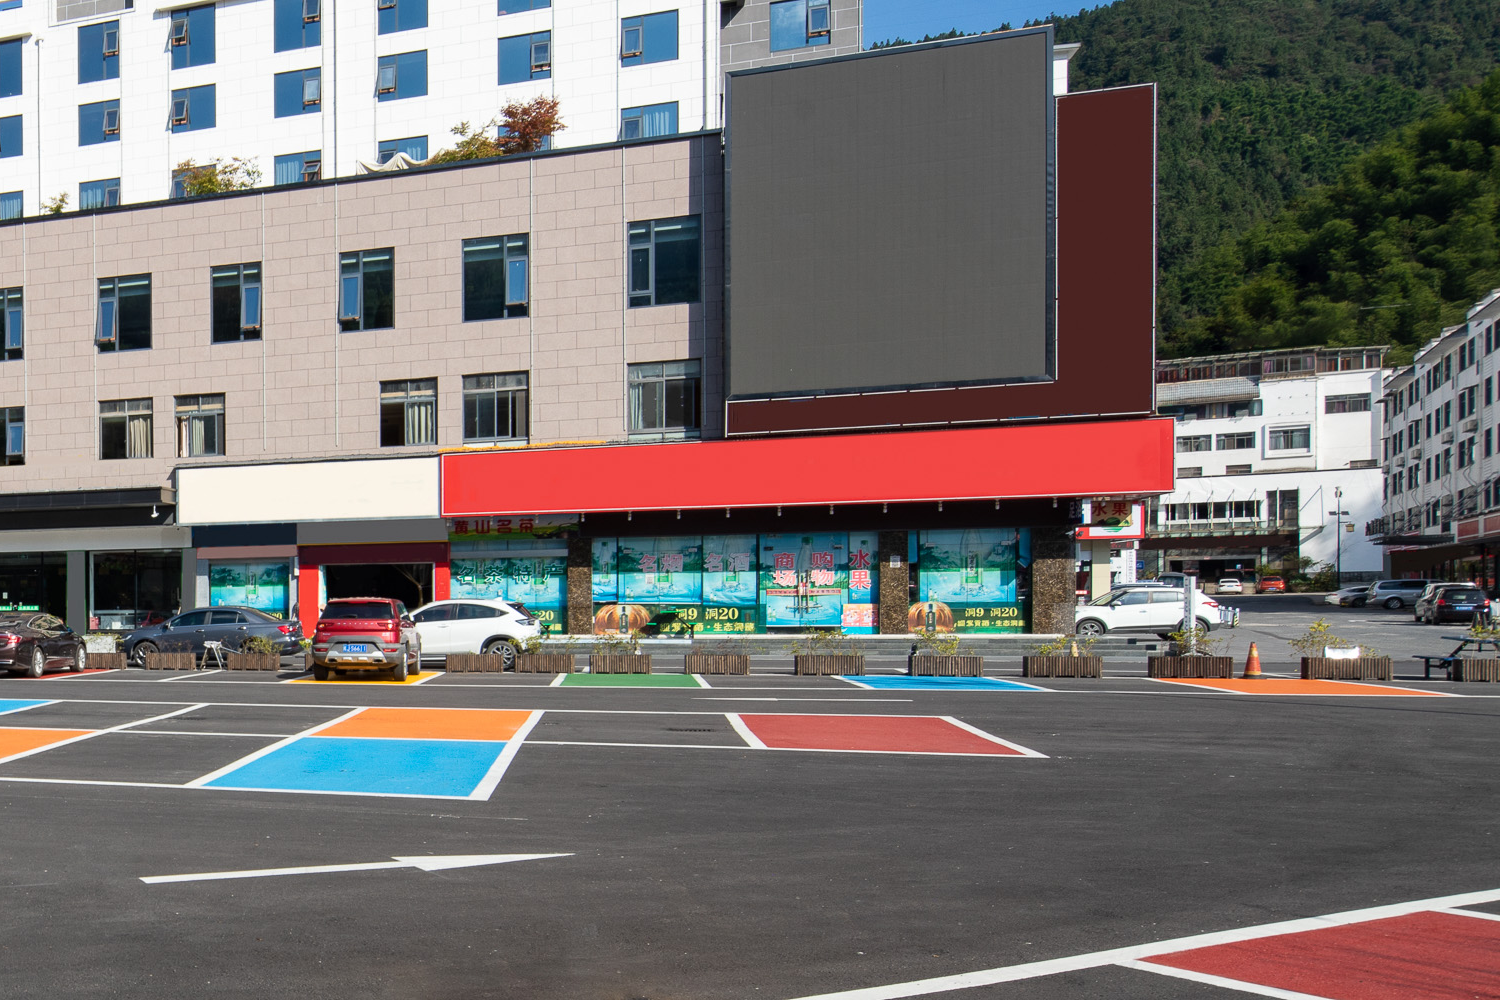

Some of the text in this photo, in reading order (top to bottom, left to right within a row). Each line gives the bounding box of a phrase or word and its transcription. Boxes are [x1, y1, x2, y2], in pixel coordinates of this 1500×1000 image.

[1092, 502, 1128, 517] 水果
[454, 517, 535, 536] 黄山名茶
[638, 552, 750, 573] 名烟 名酒
[773, 552, 797, 587] 商场
[810, 551, 836, 587] 购物
[849, 549, 871, 589] 水果
[457, 563, 564, 584] 名茶特产
[705, 607, 739, 620] 洞20
[964, 607, 1018, 618] 洞9 洞20
